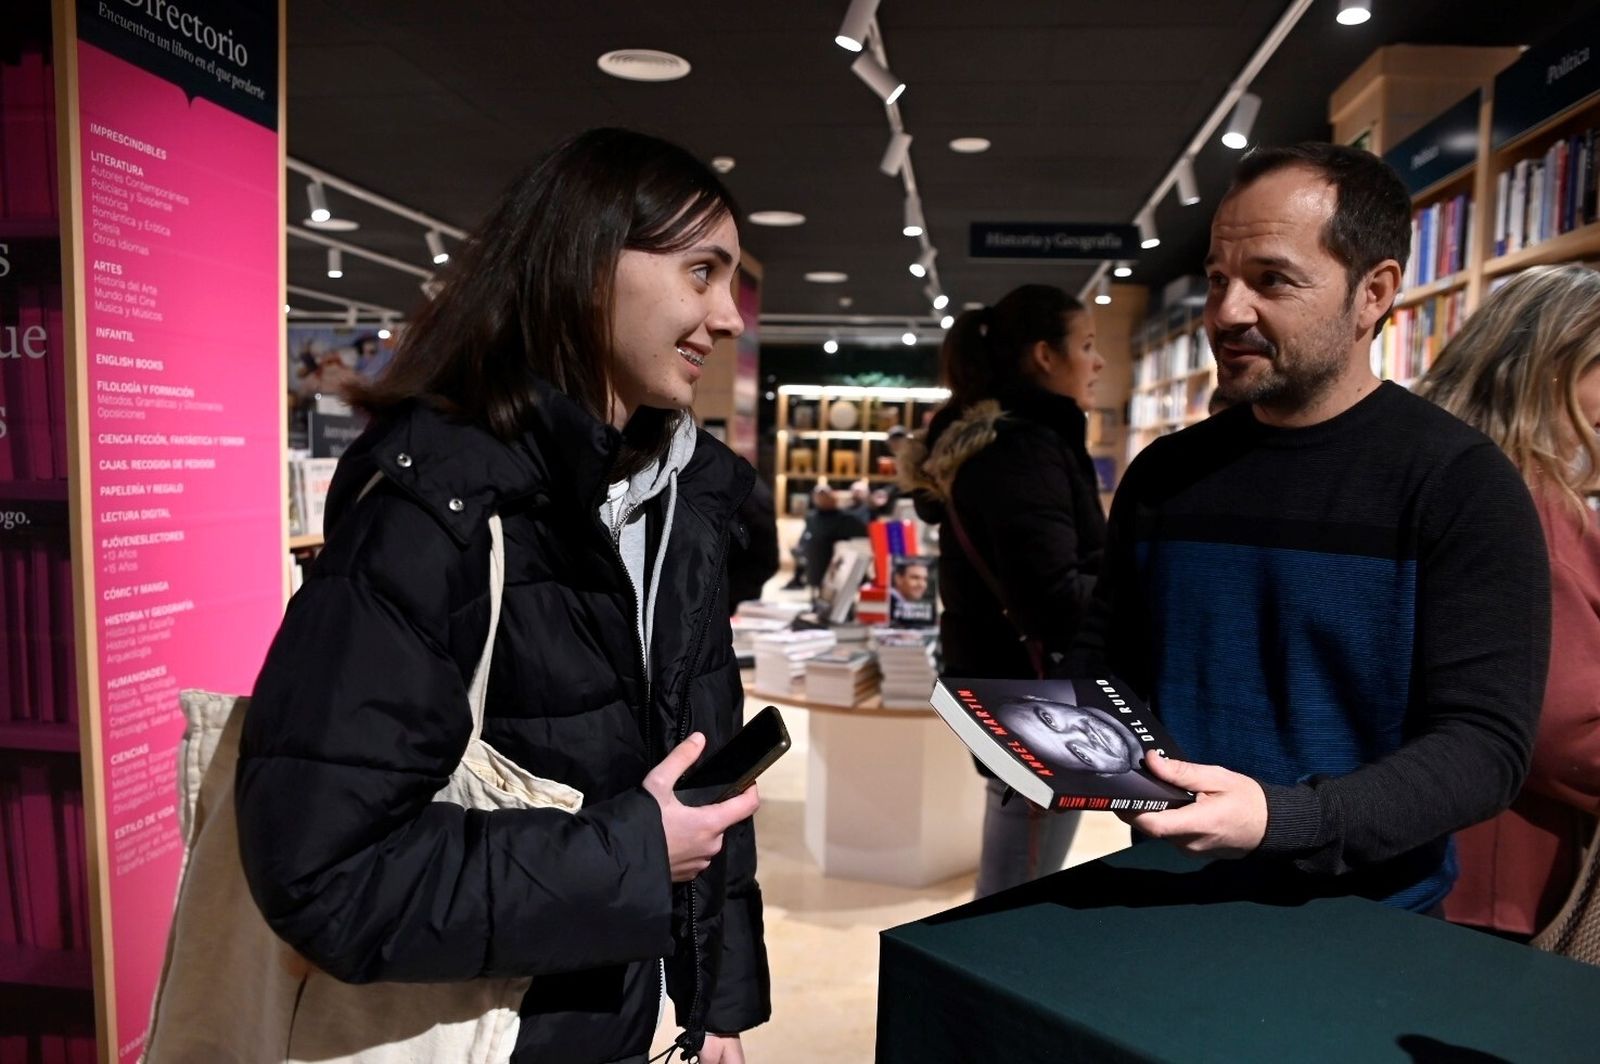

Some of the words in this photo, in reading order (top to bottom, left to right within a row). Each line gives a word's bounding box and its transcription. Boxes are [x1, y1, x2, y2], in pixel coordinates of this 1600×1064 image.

[121, 0, 249, 67] irectorio
[98, 2, 156, 44] Encuentra
[157, 37, 171, 52] un
[172, 40, 194, 63] libro
[195, 56, 206, 70] en
[207, 60, 216, 75] el
[216, 67, 232, 83] que
[232, 75, 266, 100] perderte
[90, 123, 167, 160] IMPRESCINDIBLES
[90, 151, 144, 176] LITERATURA
[91, 165, 124, 185] Autores
[93, 232, 116, 248] Otros
[118, 238, 150, 256] Idiomas
[985, 231, 1041, 249] Historia
[93, 260, 122, 275] ARTES
[94, 274, 126, 290] Historia
[127, 279, 139, 291] del
[94, 287, 124, 303] Mundo
[125, 292, 138, 305] del
[96, 327, 135, 342] INFANTIL
[96, 354, 134, 368] ENGLISH
[135, 358, 164, 372] BOOKS
[97, 380, 141, 394] FILOLOGÍA
[142, 383, 149, 394] Y
[149, 384, 195, 398] FORMACIÓN
[98, 433, 133, 445] CIENCIA
[130, 459, 172, 470] RECOGIDA
[173, 459, 183, 470] DE
[100, 483, 146, 496] PAPELERÍA
[153, 482, 184, 494] REGALO
[101, 511, 140, 523] LECTURA
[140, 508, 171, 521] DIGITAL
[104, 587, 131, 600] CÓMIC
[140, 581, 169, 594] MANGA
[105, 609, 144, 626] HISTORIA
[107, 664, 167, 689] HUMANIDADES
[1096, 679, 1133, 714] RUIDO
[1130, 719, 1155, 742] DEL
[110, 743, 149, 765] CIENCIAS
[1132, 799, 1144, 810] DEL
[114, 818, 144, 840] ESTILO
[144, 812, 156, 827] DE
